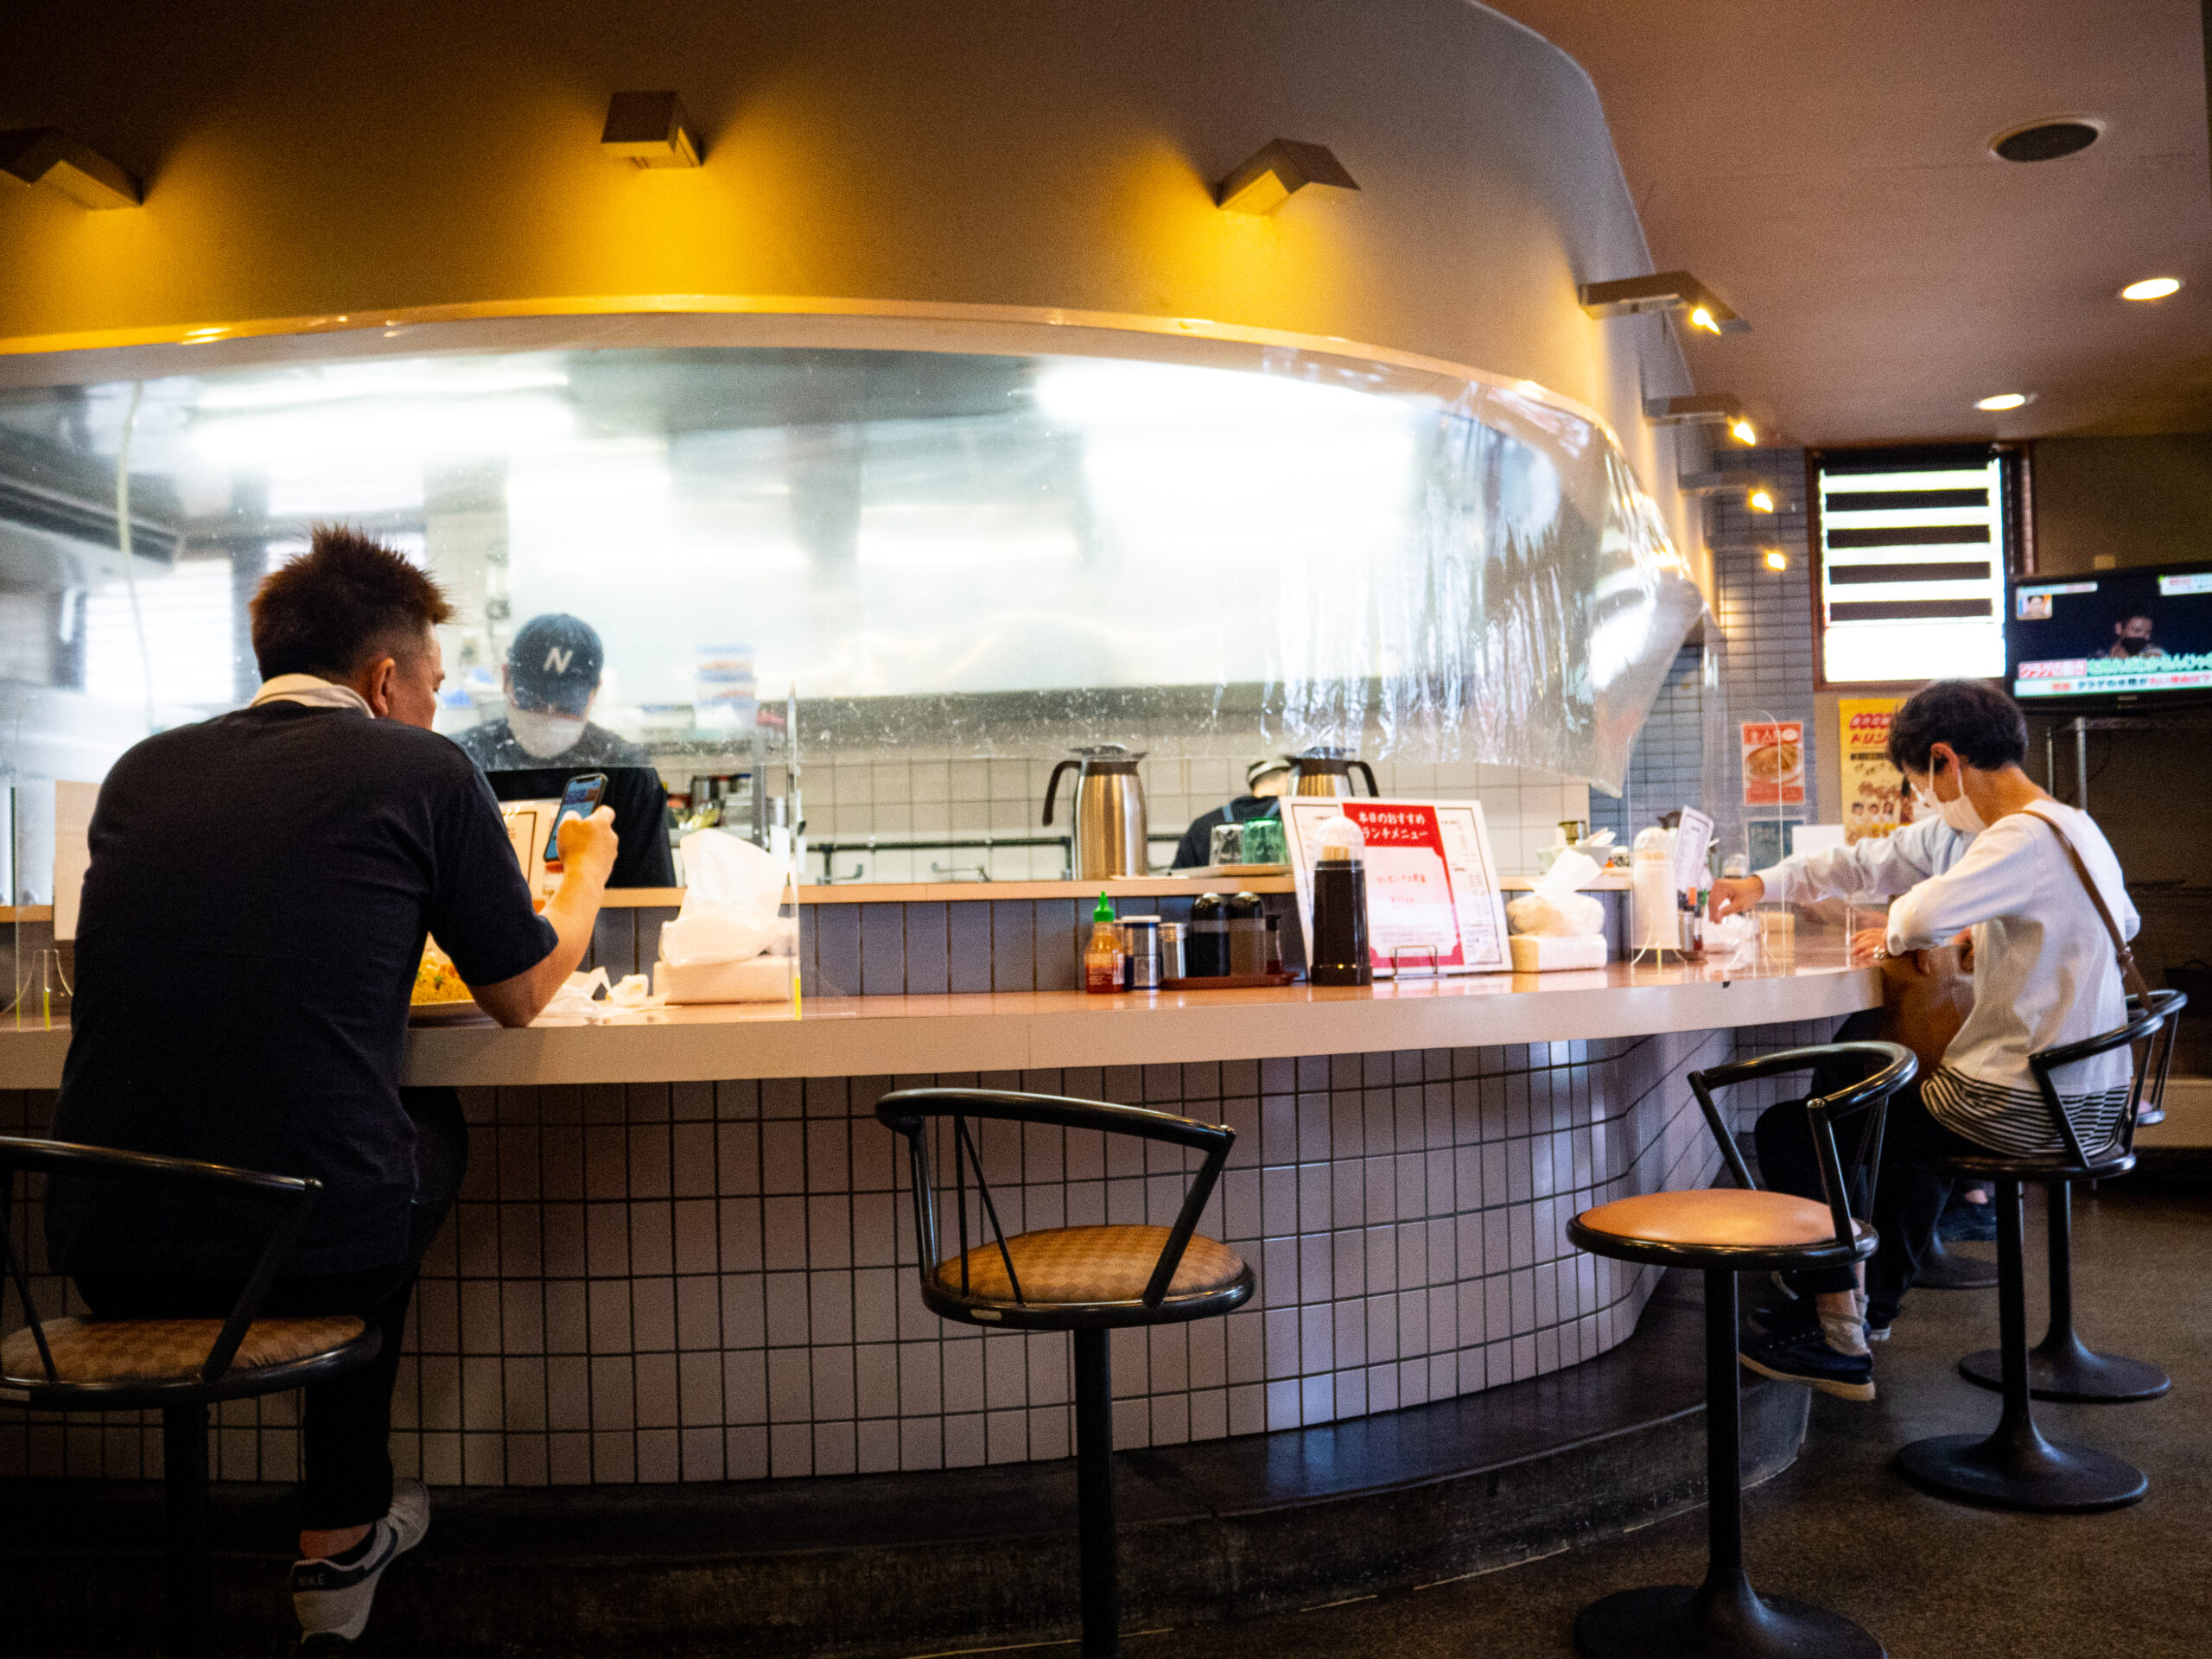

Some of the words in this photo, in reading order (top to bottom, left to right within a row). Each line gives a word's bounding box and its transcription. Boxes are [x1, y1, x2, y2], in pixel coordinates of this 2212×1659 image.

[543, 647, 573, 674] N
[1851, 733, 1889, 745] ドリン
[1359, 811, 1425, 825] 本日のおすすめ
[1363, 826, 1429, 840] ランチメニュー
[297, 1573, 326, 1587] NIKE
